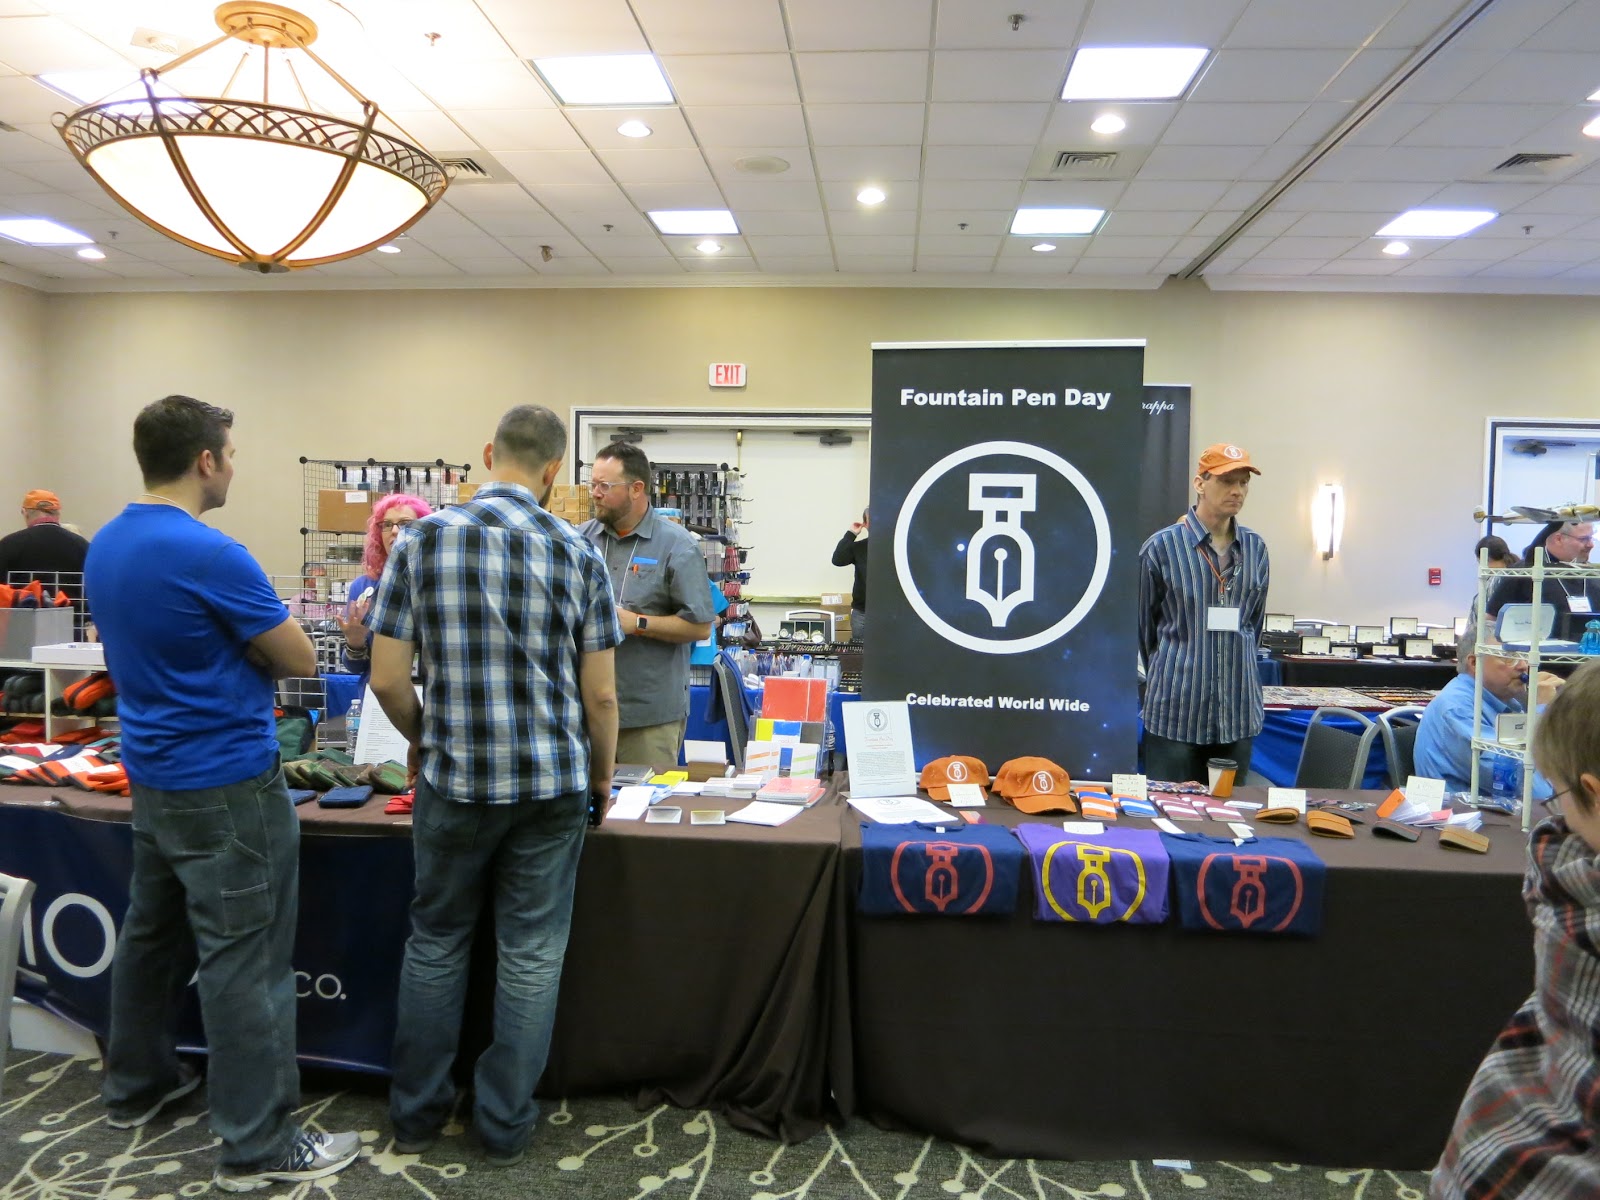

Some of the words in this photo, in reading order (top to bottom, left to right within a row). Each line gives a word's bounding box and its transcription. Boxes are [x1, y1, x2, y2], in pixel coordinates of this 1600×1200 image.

[715, 364, 741, 384] EXIT
[901, 388, 1003, 406] Fountain
[1012, 388, 1056, 406] Pen
[1065, 388, 1111, 410] Day
[905, 692, 993, 708] Celebrated
[998, 696, 1044, 710] World
[1049, 698, 1090, 712] Wide
